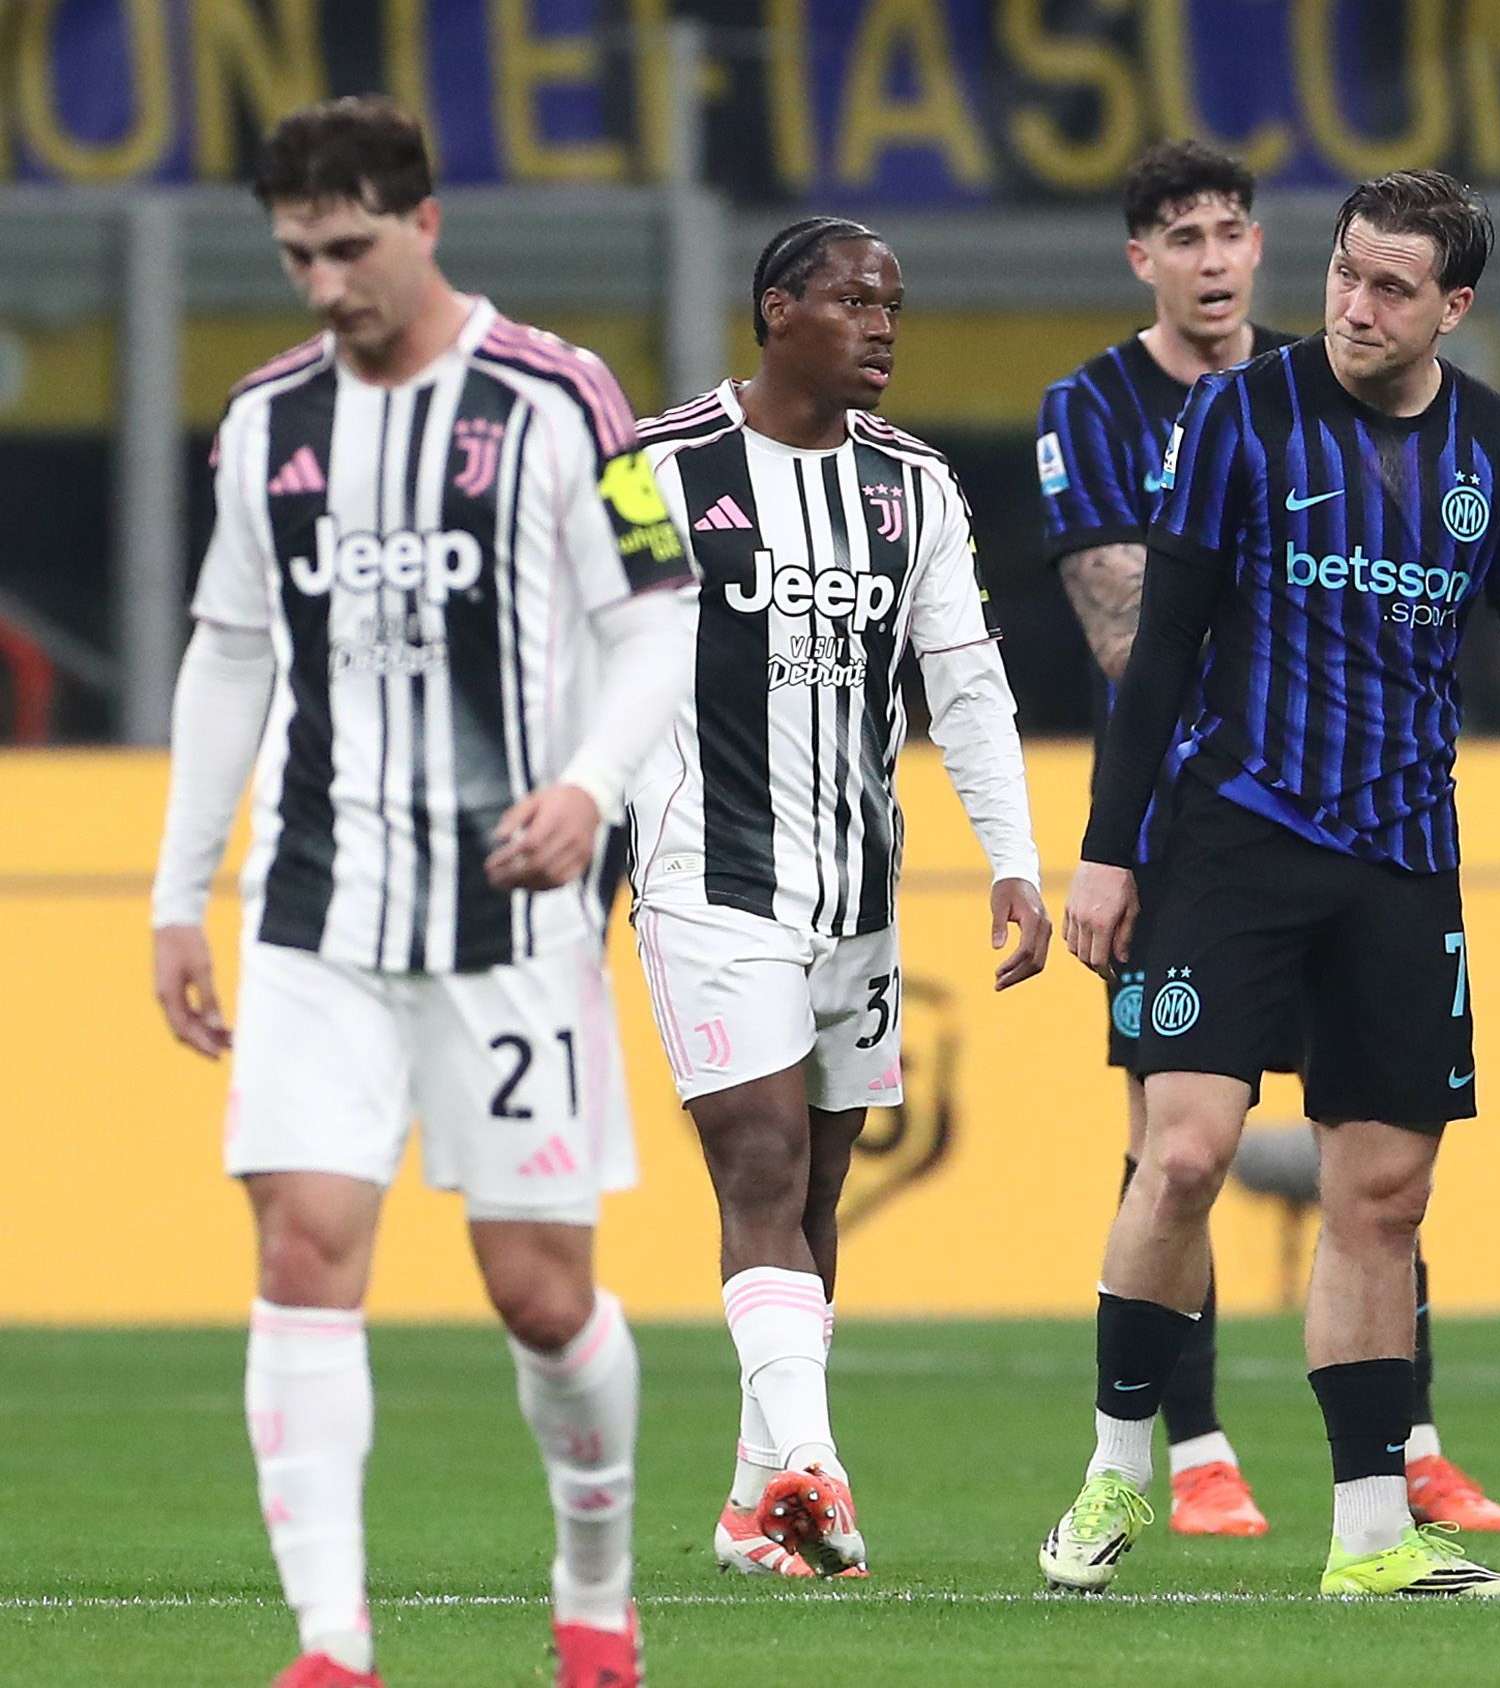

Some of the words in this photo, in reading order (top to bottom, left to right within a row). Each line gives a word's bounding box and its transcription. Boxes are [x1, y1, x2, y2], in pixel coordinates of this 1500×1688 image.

[289, 513, 484, 604] Jeep
[724, 549, 896, 633] Jeep
[1286, 541, 1473, 603] betsson
[767, 653, 867, 692] Detroit
[790, 635, 846, 659] VISIT
[1444, 932, 1465, 1017] 7
[488, 1029, 578, 1120] 21
